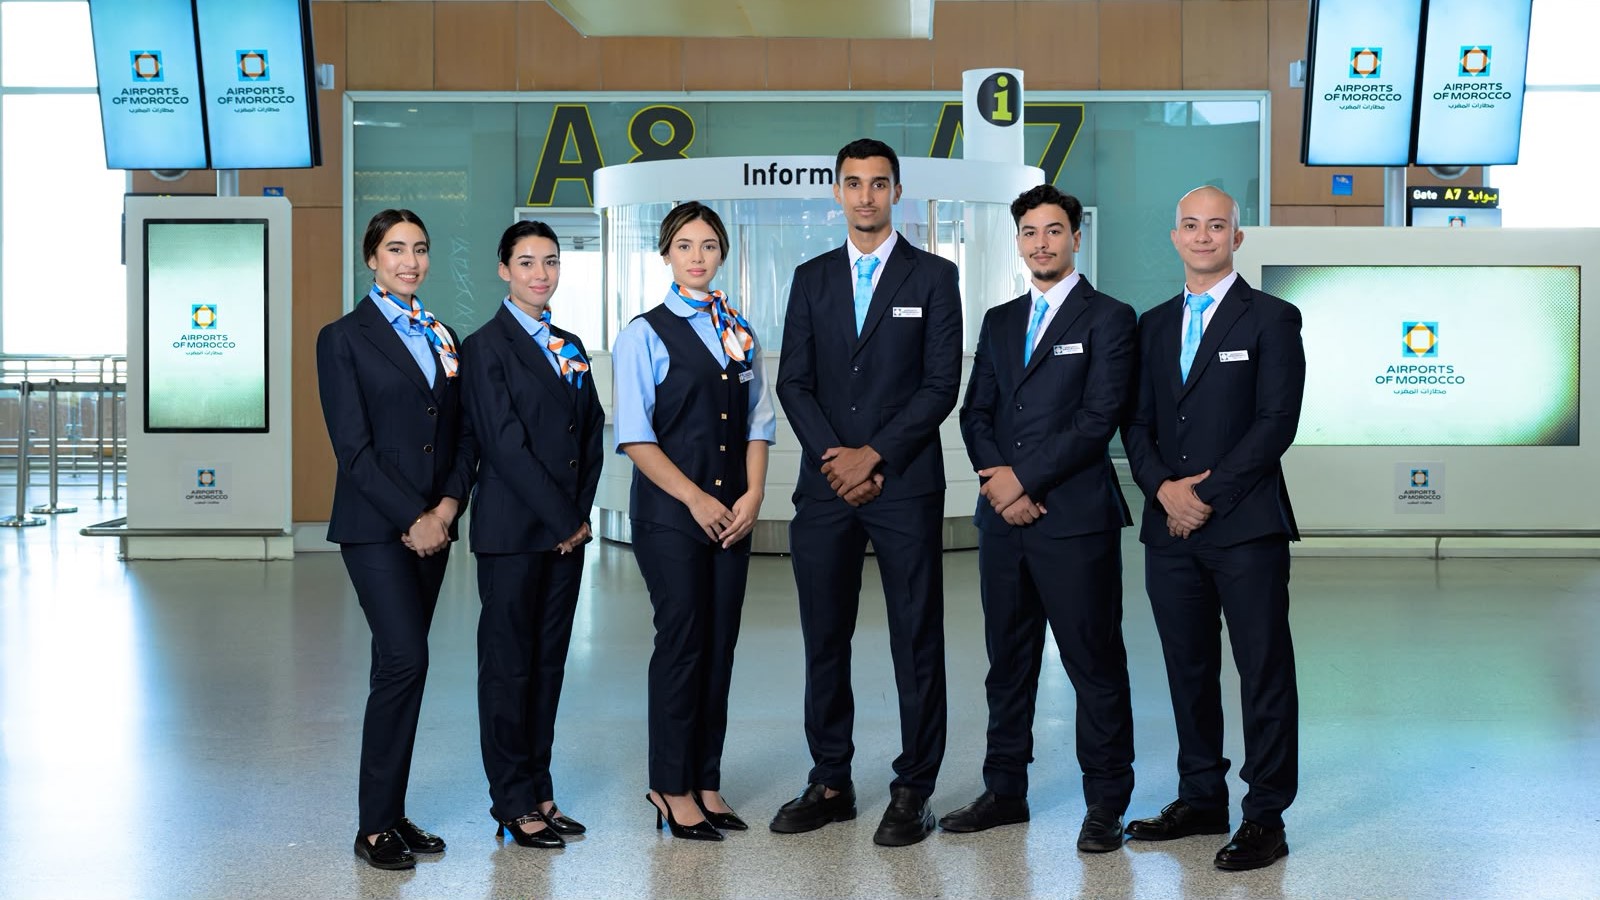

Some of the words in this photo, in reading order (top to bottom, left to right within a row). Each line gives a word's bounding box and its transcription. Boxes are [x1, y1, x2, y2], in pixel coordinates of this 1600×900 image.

[226, 87, 285, 95] AIRPORTS
[1334, 84, 1393, 92] AIRPORTS
[1443, 82, 1503, 91] AIRPORTS
[121, 87, 179, 96] AIRPORTS
[1433, 92, 1449, 100] OF
[1451, 91, 1512, 100] MOROCCO
[112, 96, 128, 105] OF
[129, 96, 189, 105] MOROCCO
[217, 96, 233, 105] OF
[235, 95, 295, 104] MOROCCO
[1324, 93, 1340, 101] OF
[1342, 93, 1402, 101] MOROCCO
[743, 162, 833, 186] Inform
[1413, 189, 1438, 200] Gate
[1444, 188, 1462, 200] A7
[172, 341, 186, 349] OF
[187, 341, 236, 349] MOROCCO
[1386, 365, 1454, 374] AIRPORTS
[1375, 375, 1393, 384] OF
[1395, 375, 1465, 384] MOROCCO
